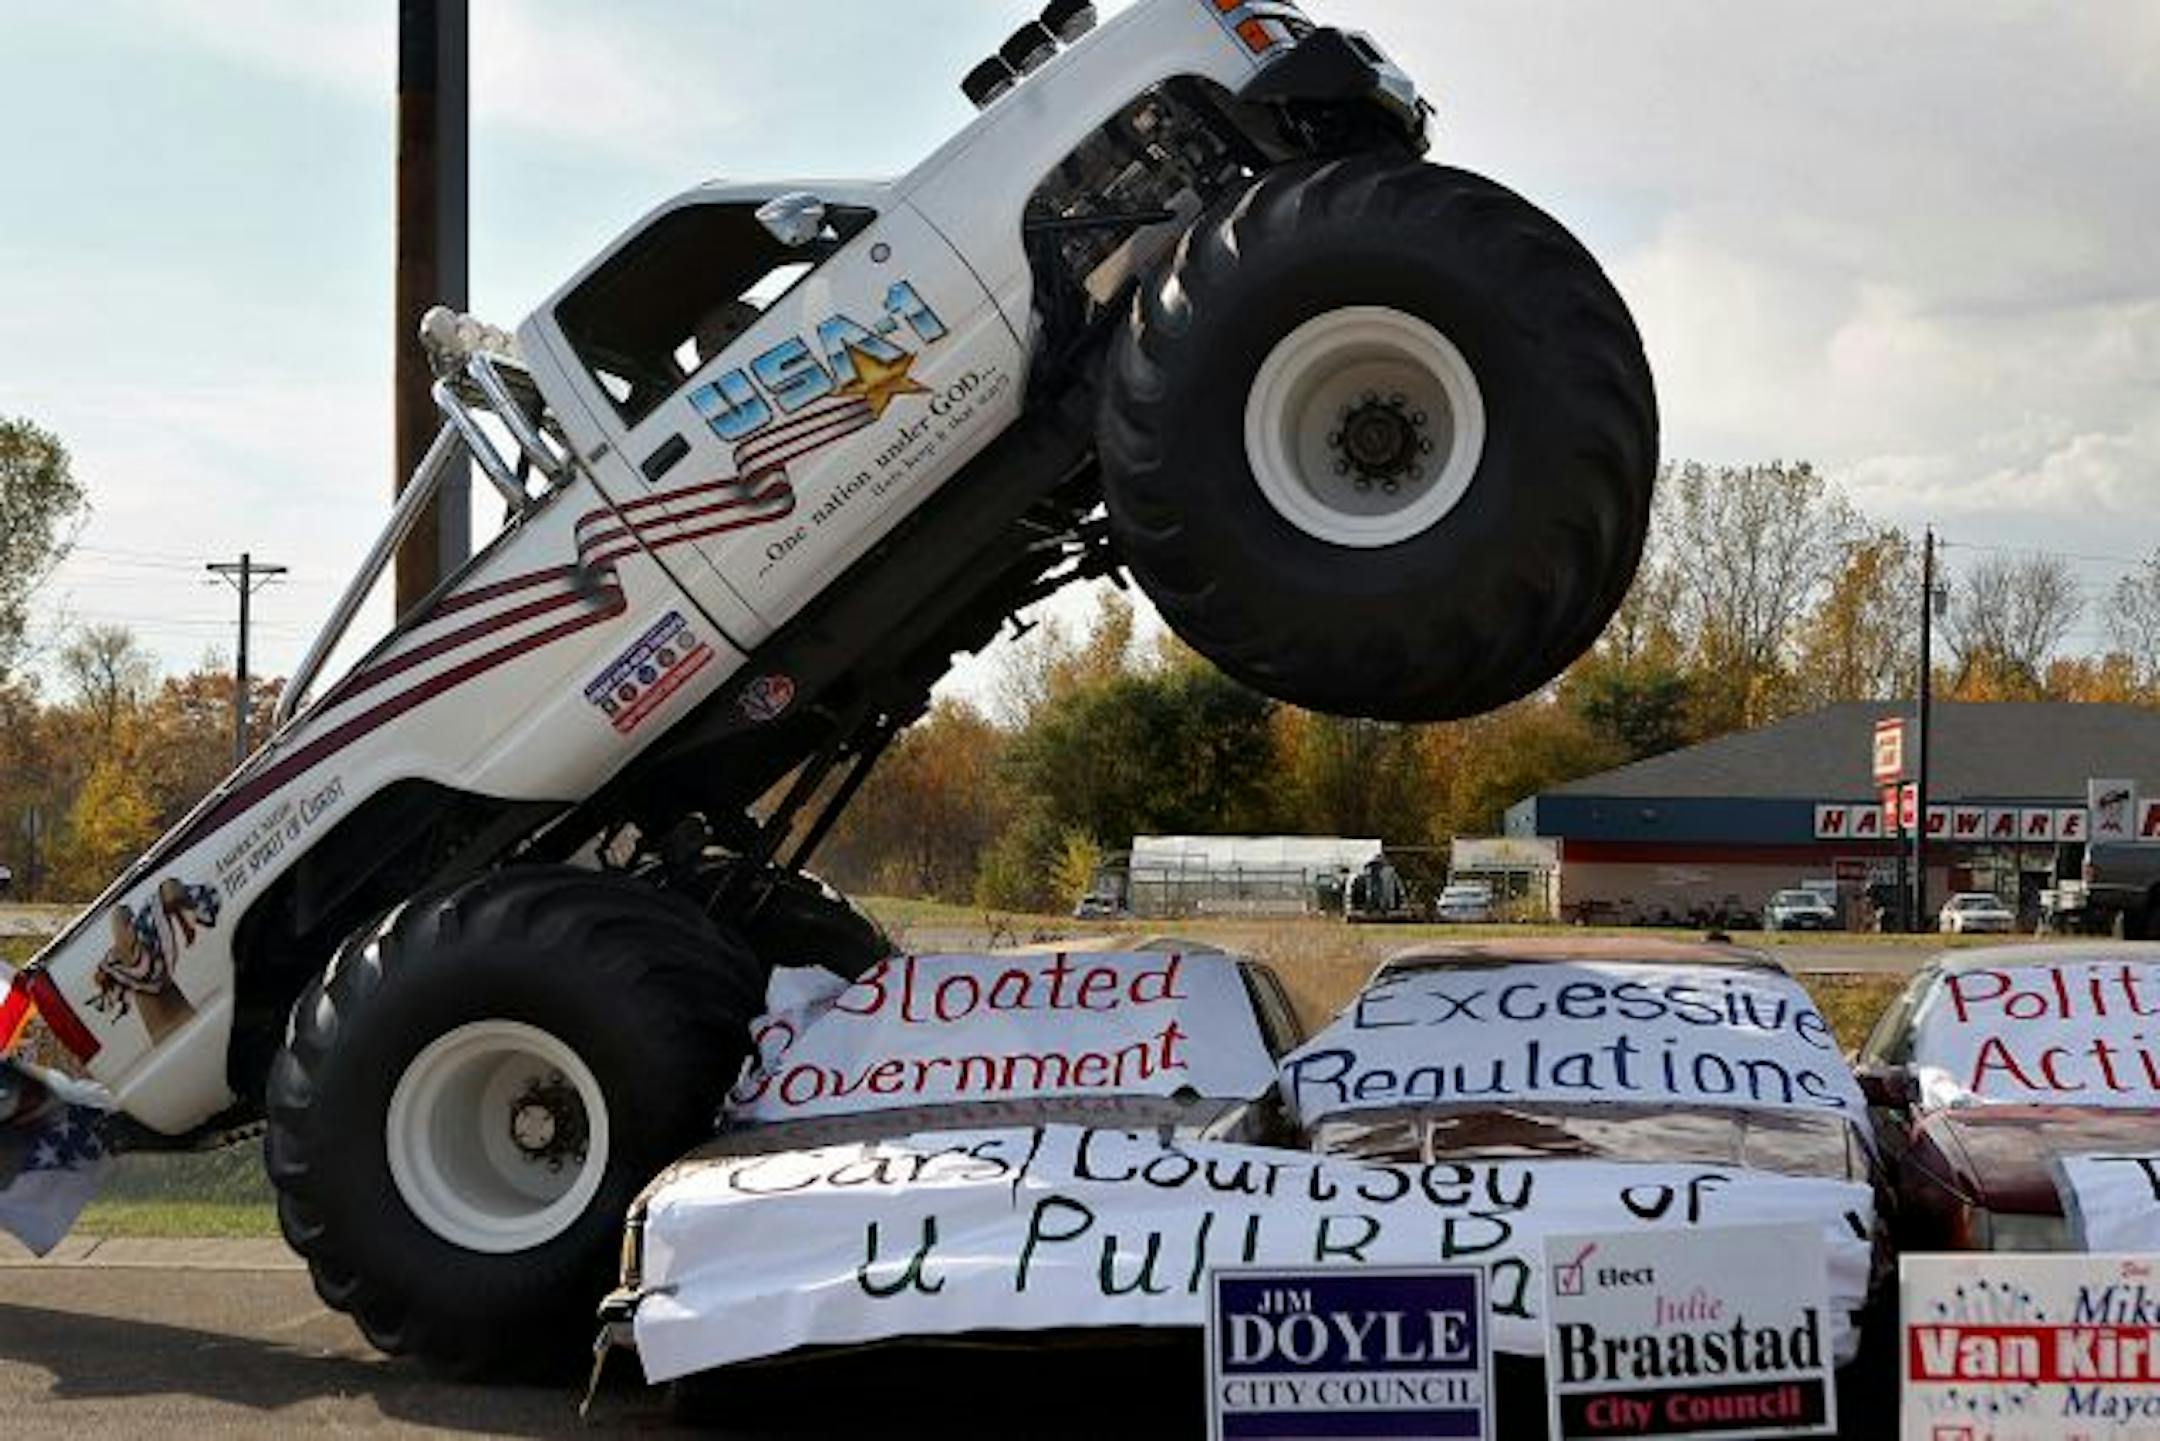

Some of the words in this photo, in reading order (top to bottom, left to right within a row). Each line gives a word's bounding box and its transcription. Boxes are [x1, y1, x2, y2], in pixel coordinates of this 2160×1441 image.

[687, 279, 949, 443] USA-1
[812, 470, 872, 525] nation
[876, 417, 930, 469] under
[1820, 808, 2080, 838] HADWARE
[834, 953, 1188, 1024] Bloated
[1354, 978, 1831, 1049] Excessive
[728, 1018, 1188, 1107] Government
[1257, 1290, 1312, 1314] JIM
[1598, 1267, 1654, 1286] Elect
[1655, 1287, 1724, 1326] Julie
[1227, 1310, 1472, 1365] DOYLE
[1556, 1306, 1823, 1383] Braastad
[1916, 1328, 2041, 1379] Van
[2055, 1328, 2160, 1379] Kir
[1224, 1379, 1307, 1405] CITY
[1317, 1377, 1480, 1405] COUNCIL
[1585, 1395, 1654, 1430] City
[1666, 1384, 1803, 1423] Council
